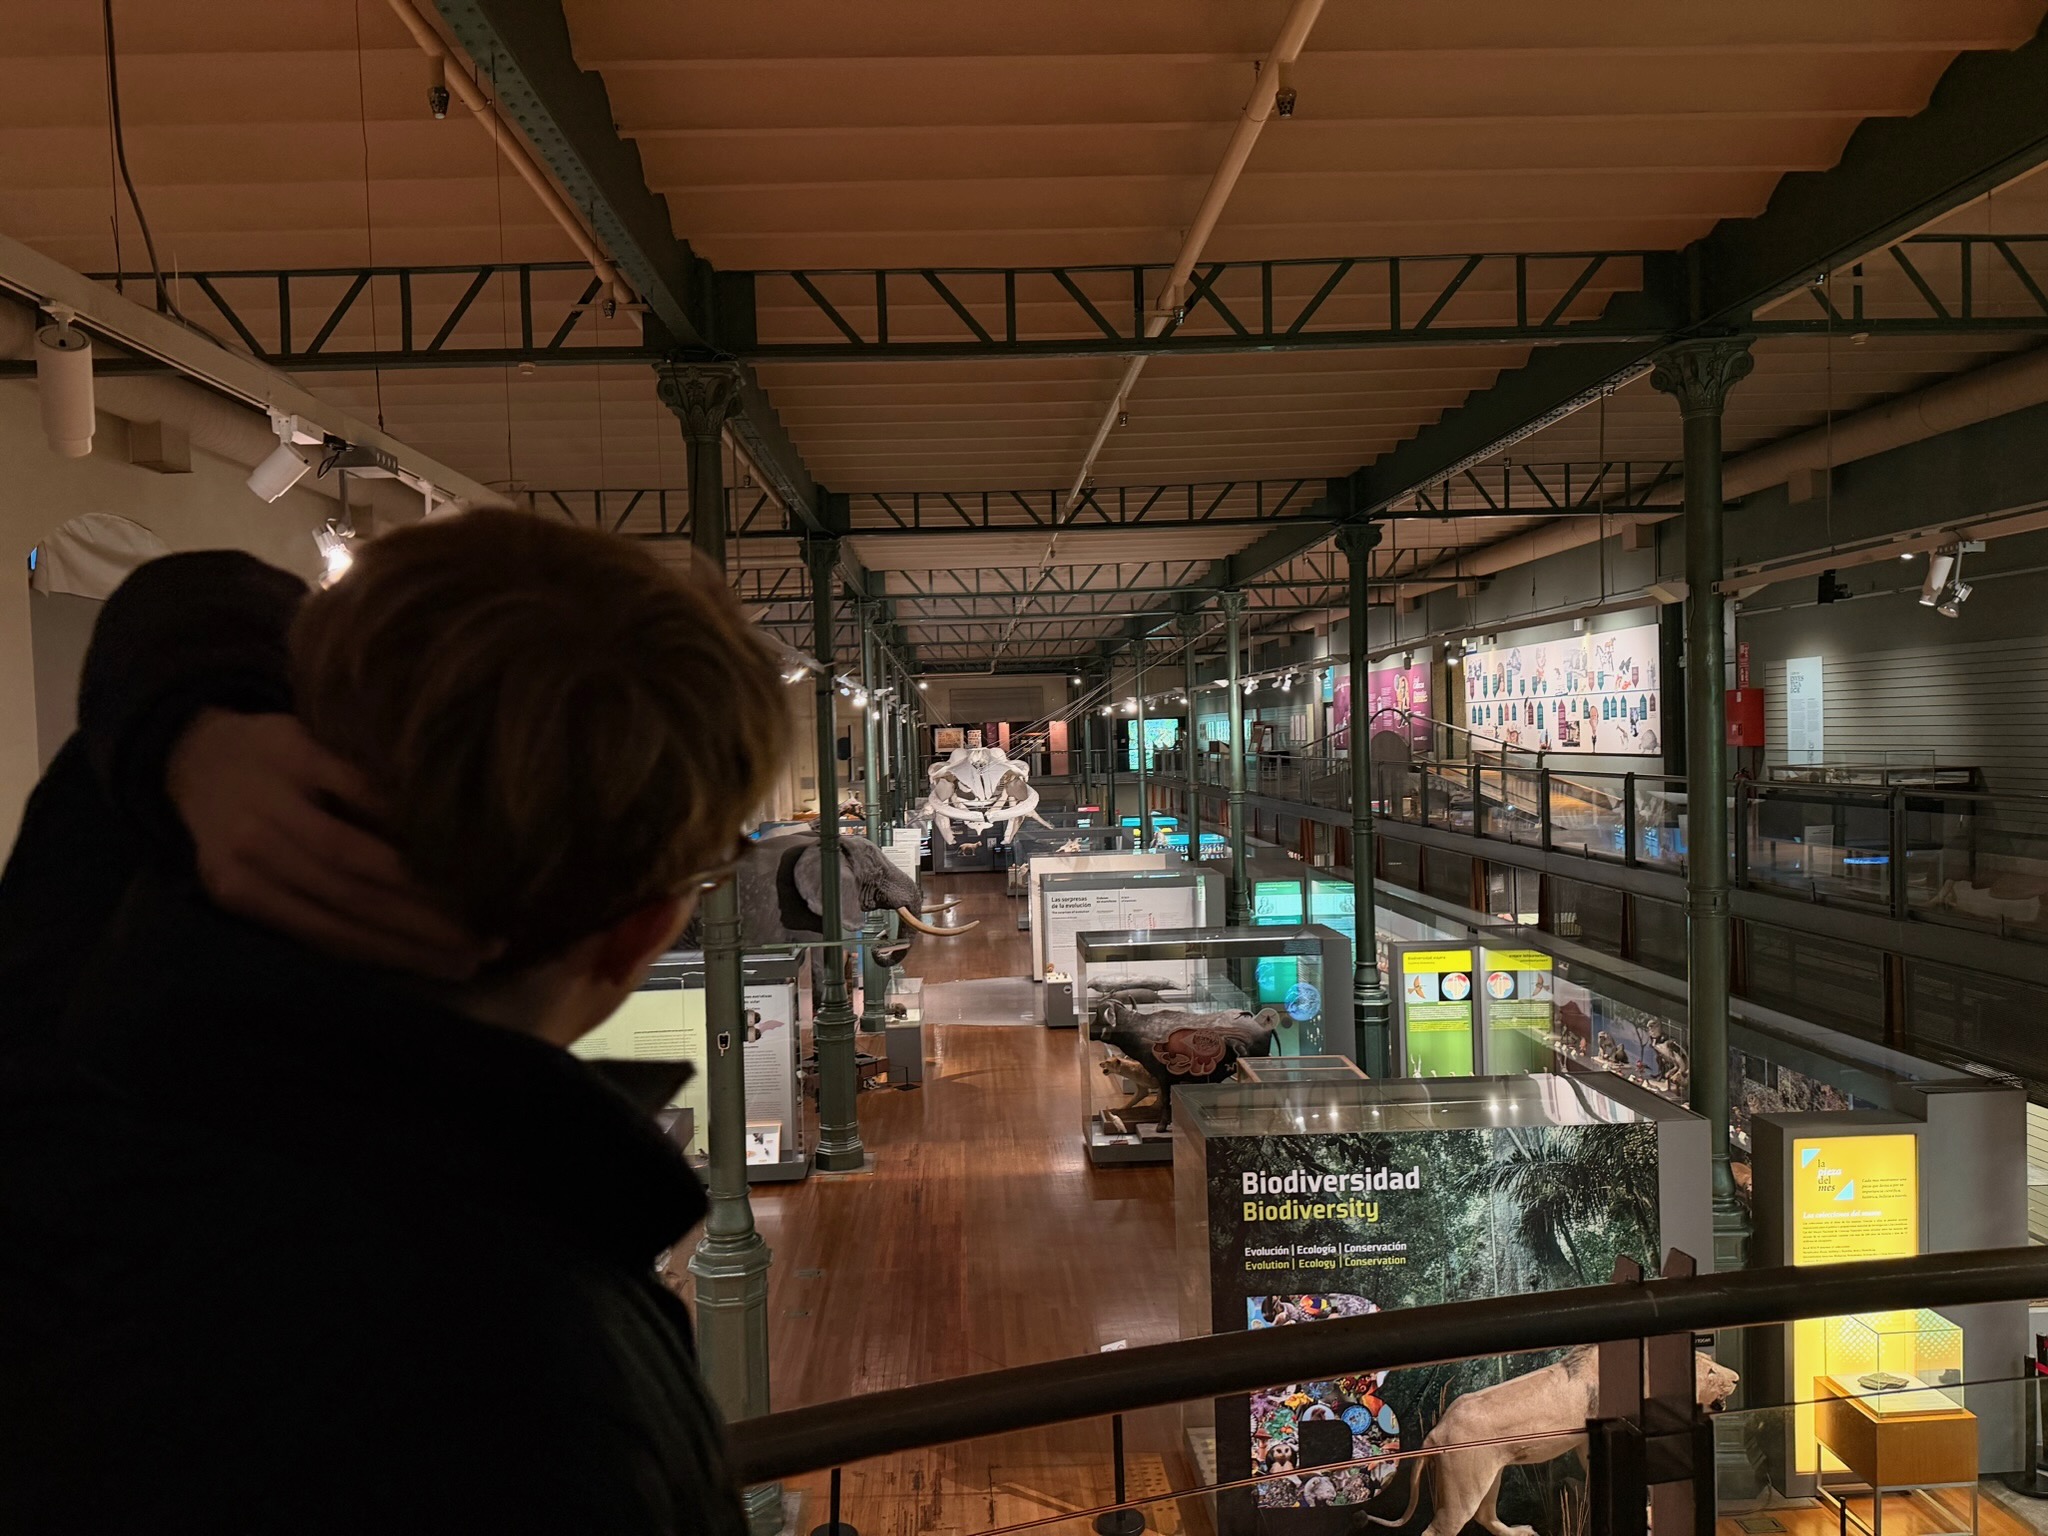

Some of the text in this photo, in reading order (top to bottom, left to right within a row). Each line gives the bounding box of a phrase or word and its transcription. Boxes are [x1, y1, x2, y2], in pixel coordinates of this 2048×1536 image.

[1817, 1159, 1826, 1168] la
[1242, 1165, 1420, 1195] Biodiversidad
[1817, 1175, 1831, 1184] del
[1243, 1198, 1379, 1223] Biodiversity
[1244, 1241, 1407, 1257] Evolución Ecología Conservación
[1245, 1256, 1407, 1271] Evolution Ecology Conservation
